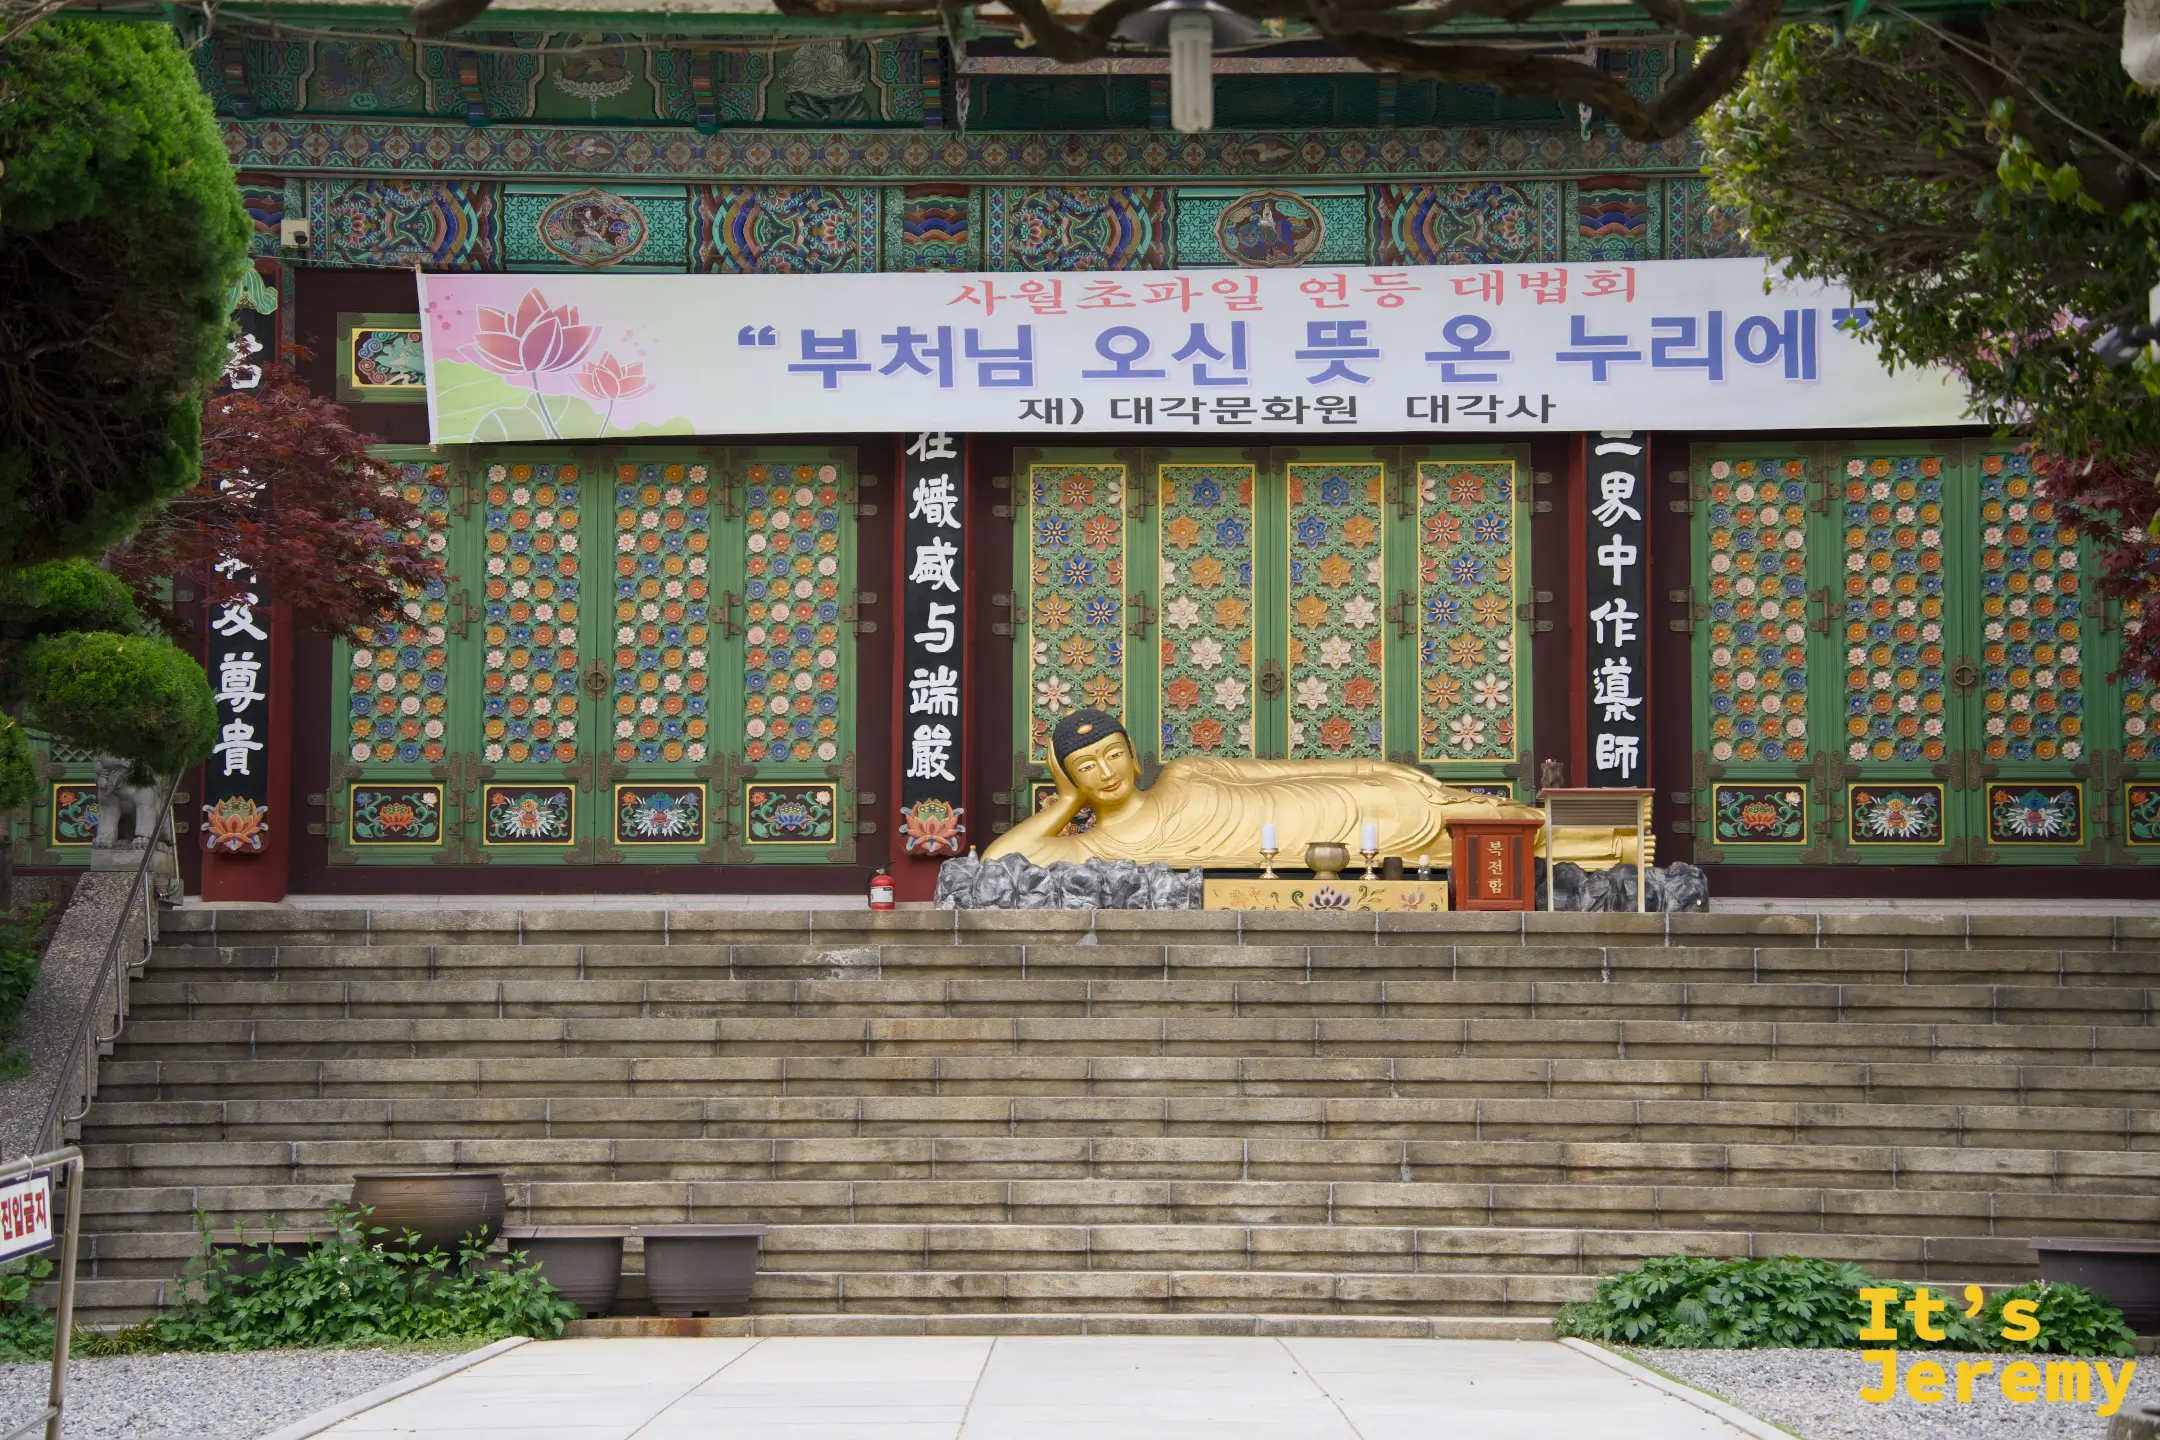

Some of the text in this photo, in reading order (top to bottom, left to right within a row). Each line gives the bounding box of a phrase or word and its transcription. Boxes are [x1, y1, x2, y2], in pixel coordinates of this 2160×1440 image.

[947, 265, 1636, 316] 사월초파일 연등 대법회
[1081, 321, 1249, 387] 오신
[1295, 320, 1380, 385] 뜻
[1425, 315, 1511, 383] 온
[1110, 395, 1358, 425] 대각문화원
[1406, 394, 1557, 424] 대각사
[1487, 840, 1505, 895] 복전함
[0, 1187, 47, 1241] 진입금지
